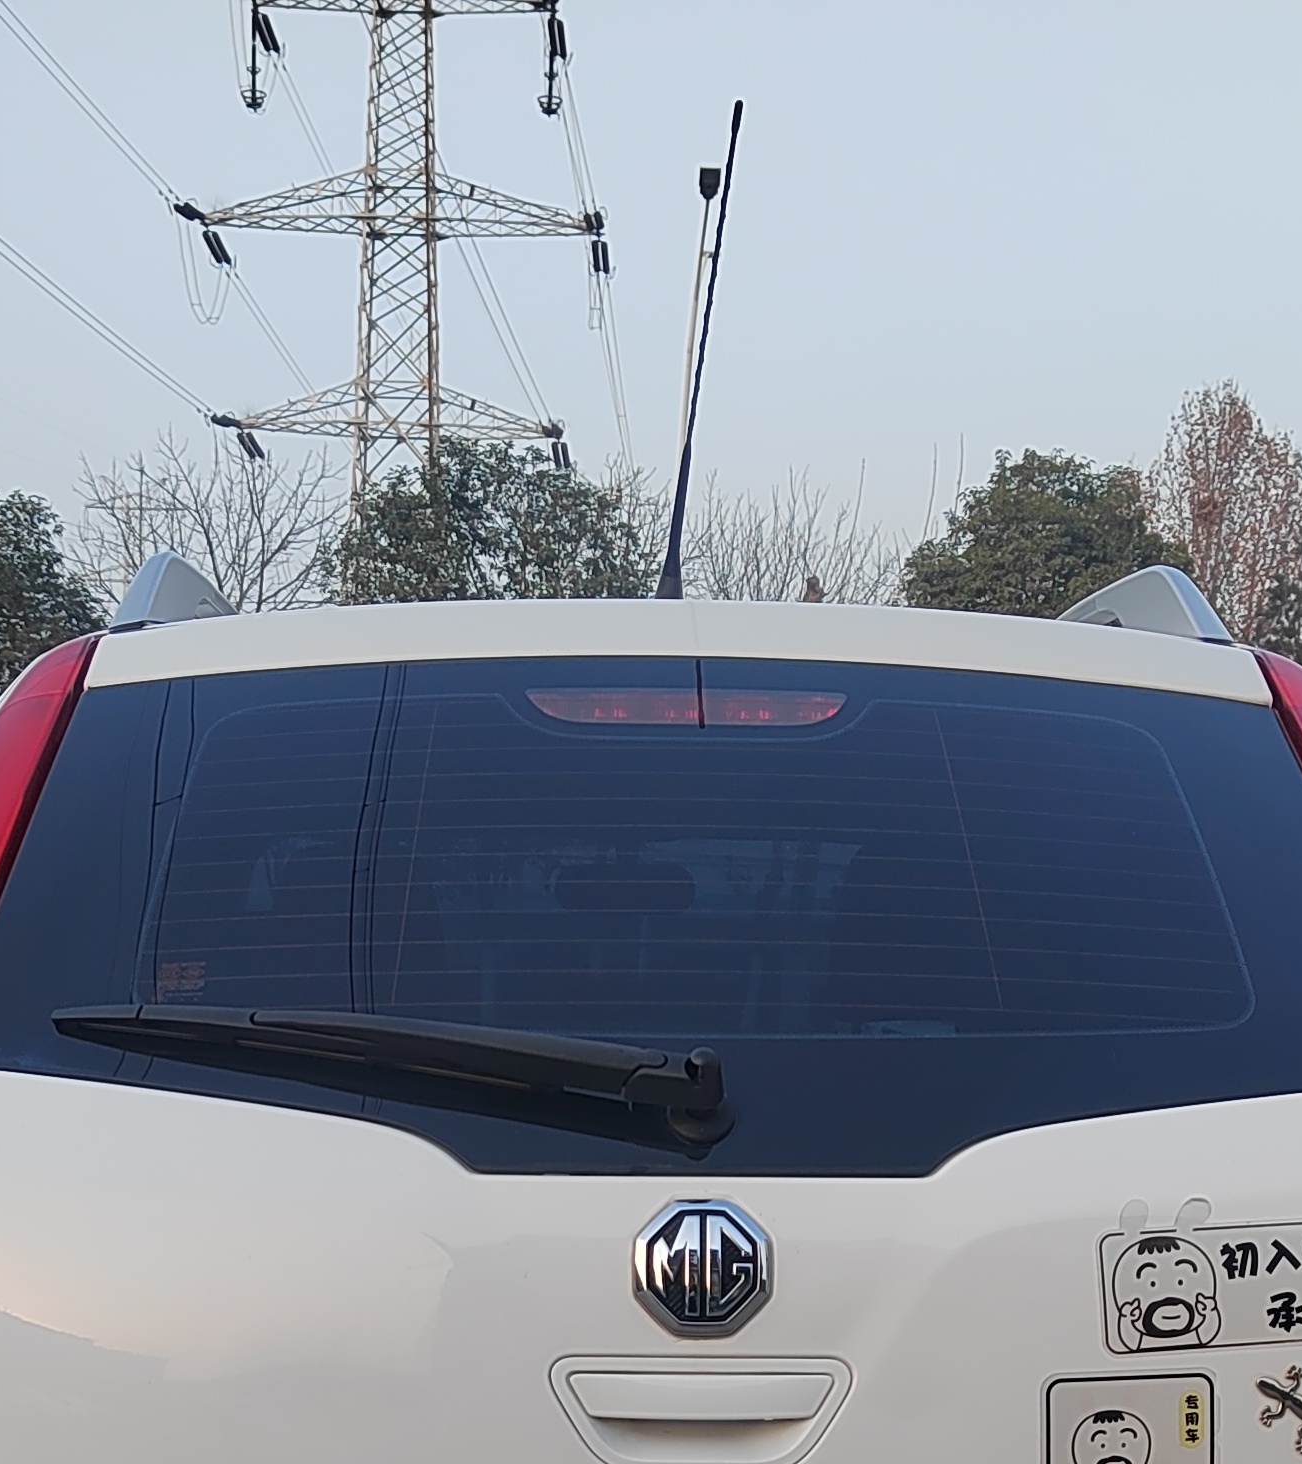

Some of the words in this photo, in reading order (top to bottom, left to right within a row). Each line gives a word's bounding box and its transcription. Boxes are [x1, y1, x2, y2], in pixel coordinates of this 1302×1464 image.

[650, 1211, 756, 1319] MG
[1184, 1394, 1200, 1443] 专用车
